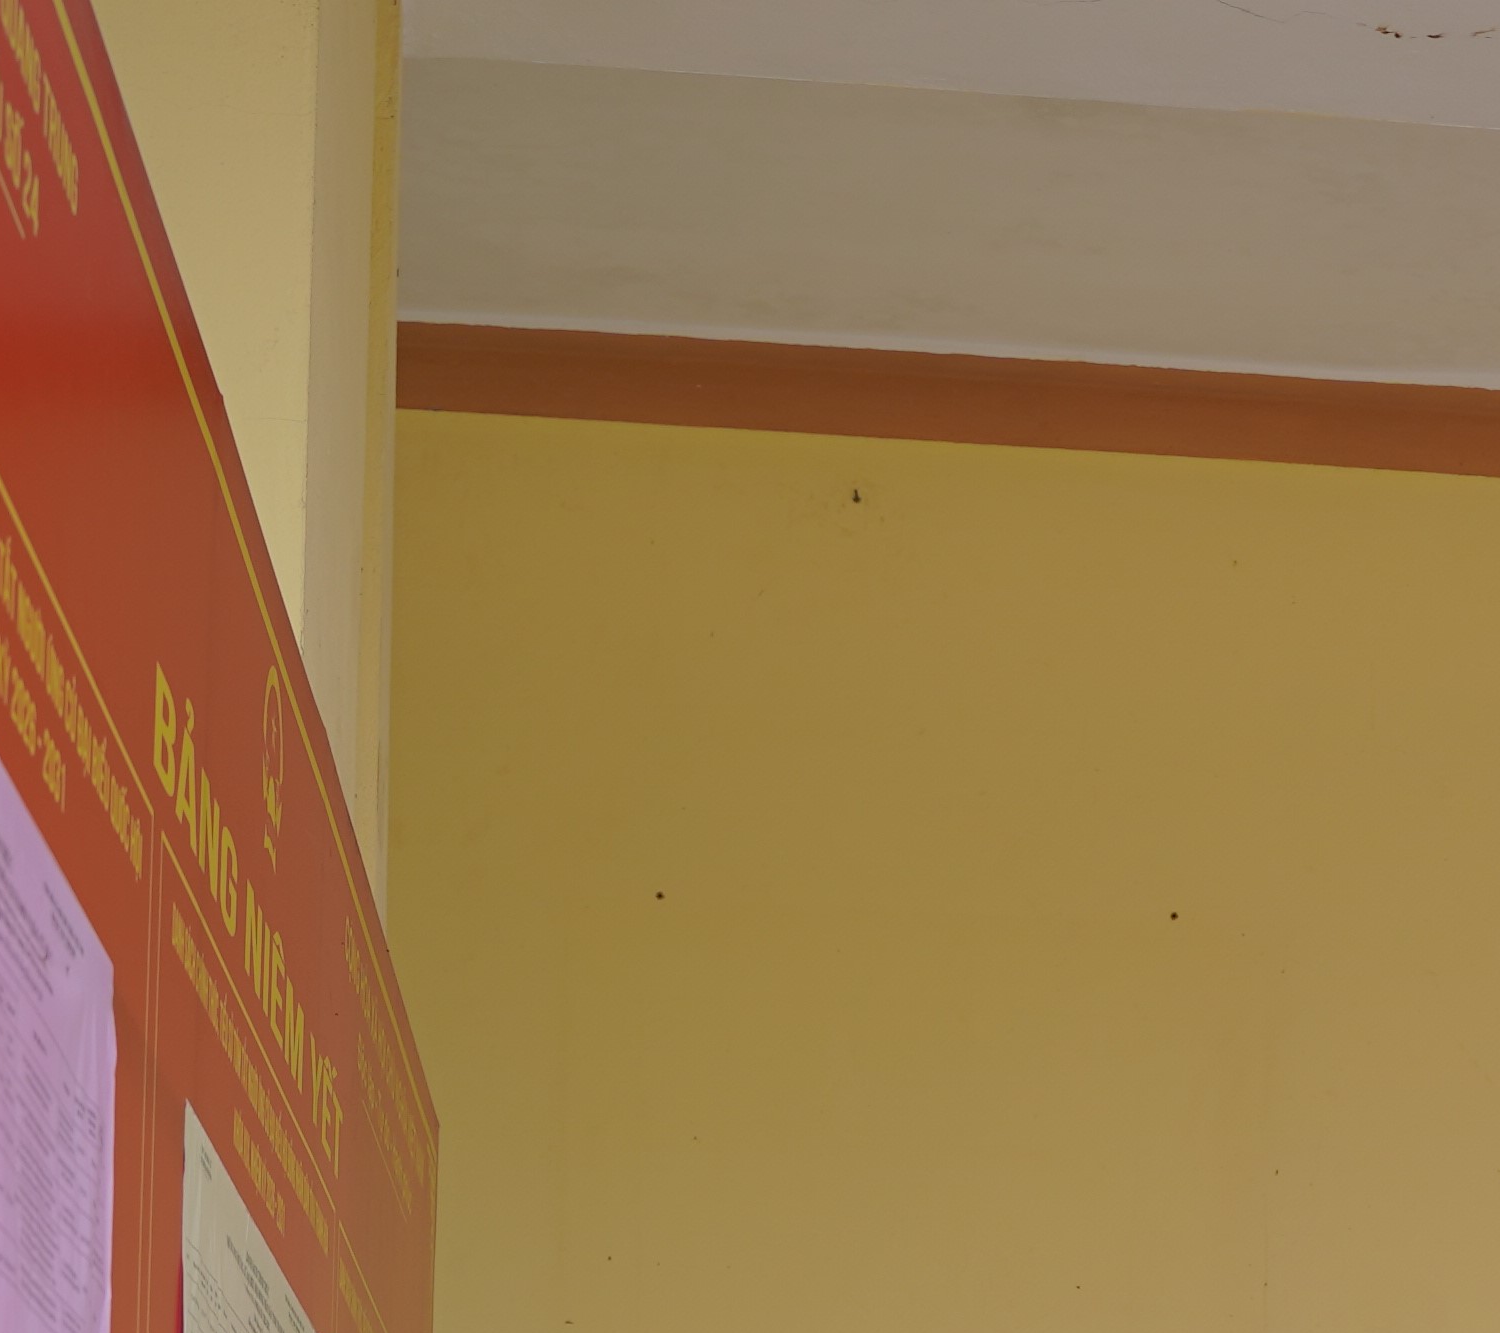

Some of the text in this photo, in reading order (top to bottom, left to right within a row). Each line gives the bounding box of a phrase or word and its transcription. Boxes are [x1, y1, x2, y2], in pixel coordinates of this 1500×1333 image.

[4, 102, 25, 190] SỐ
[22, 151, 40, 238] 24
[43, 72, 79, 216] TRUNG
[43, 728, 66, 813] 2031
[152, 661, 238, 936] BẢNG
[244, 877, 304, 1095] NIÊM
[309, 1032, 344, 1180] YẾT
